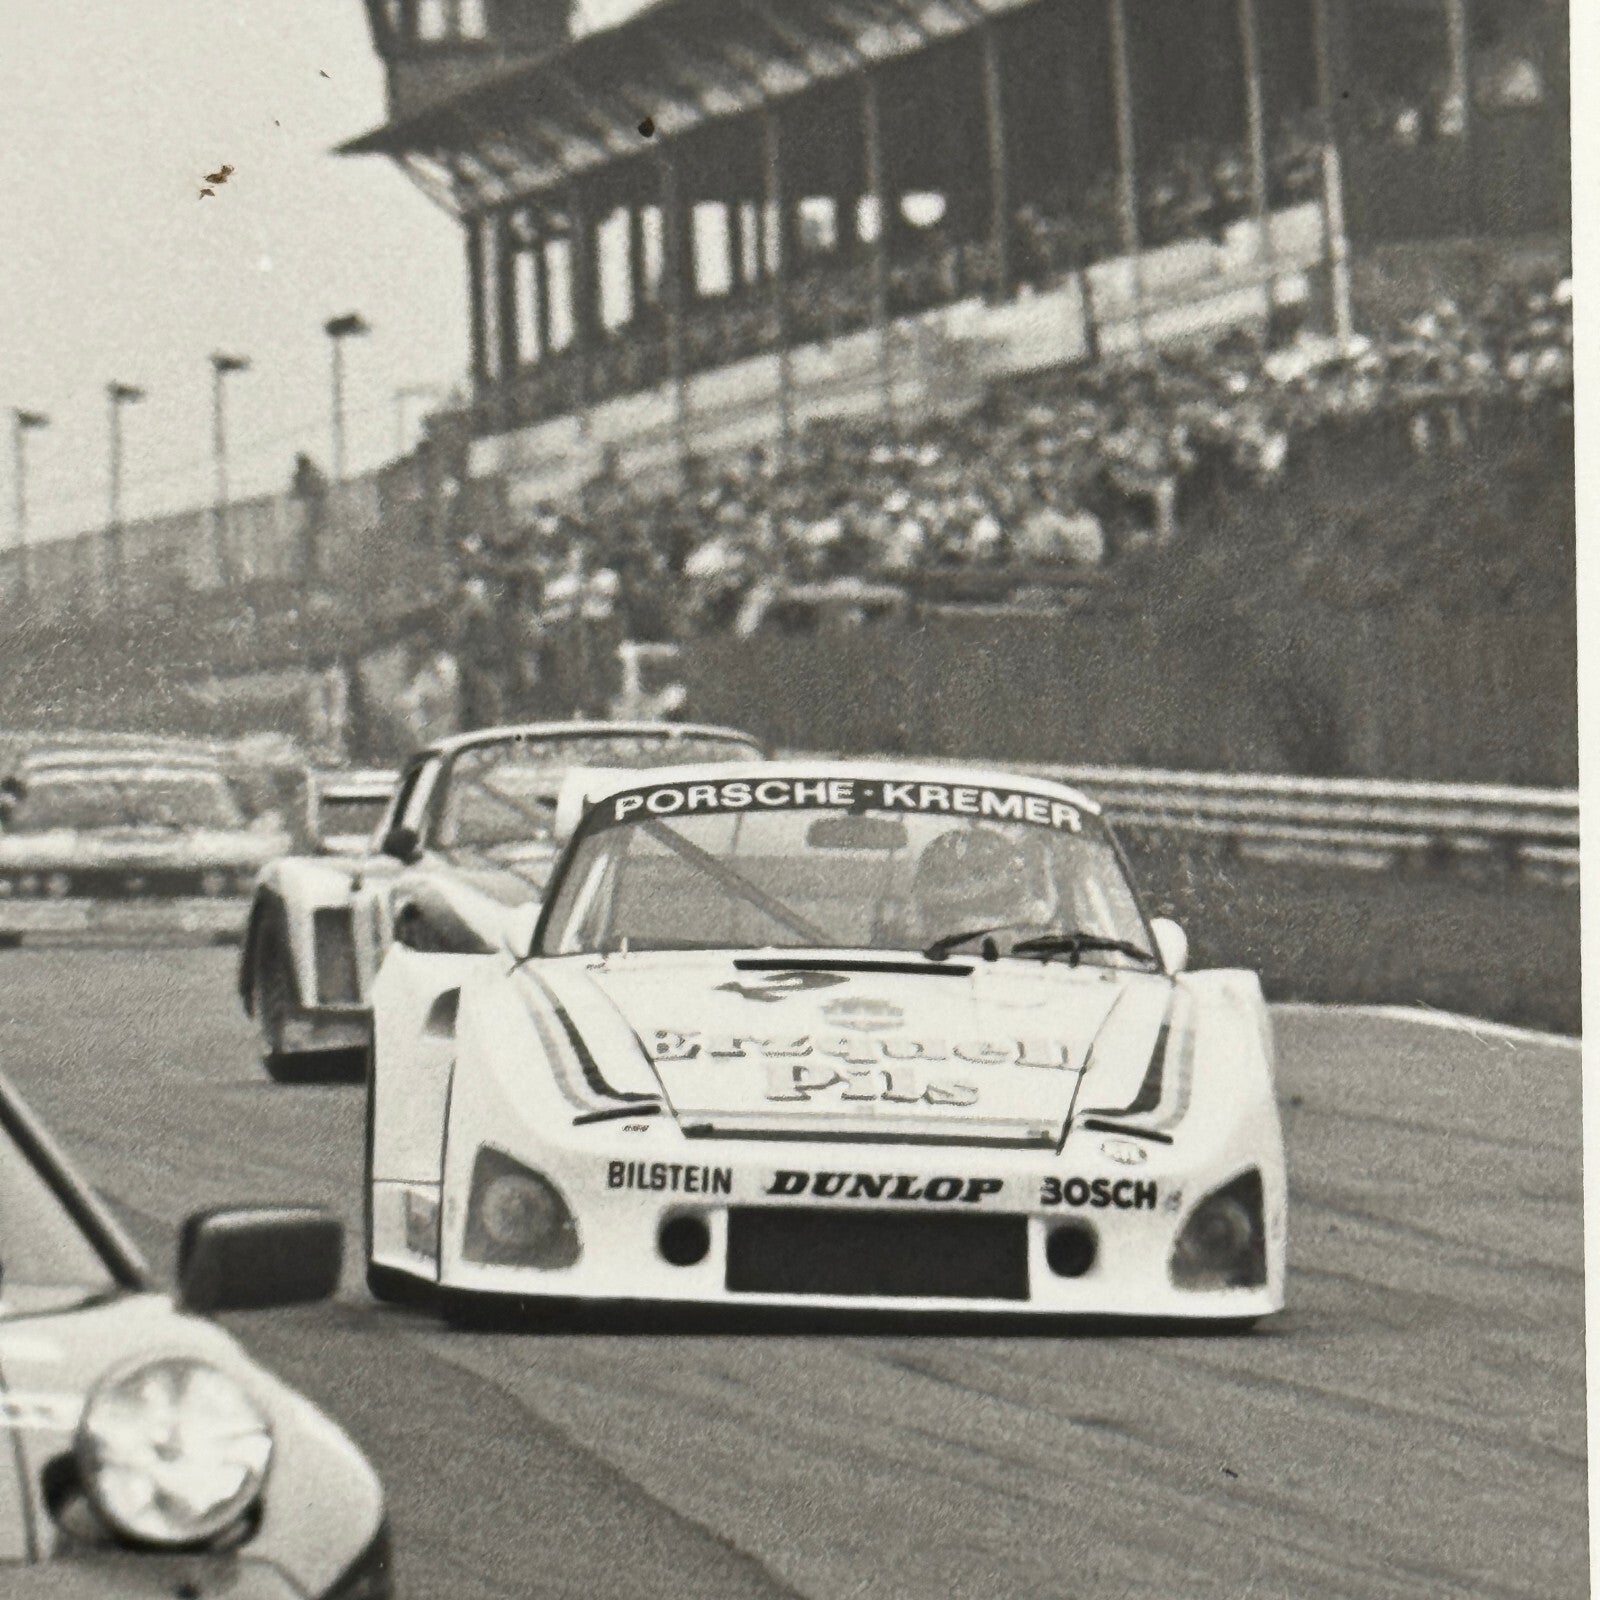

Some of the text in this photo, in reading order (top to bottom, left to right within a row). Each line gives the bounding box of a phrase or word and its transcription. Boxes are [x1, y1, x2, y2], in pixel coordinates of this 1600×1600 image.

[607, 1160, 733, 1195] BILSTEIN
[766, 1169, 1004, 1203] DUNLOP
[1039, 1175, 1158, 1211] BOSCH
